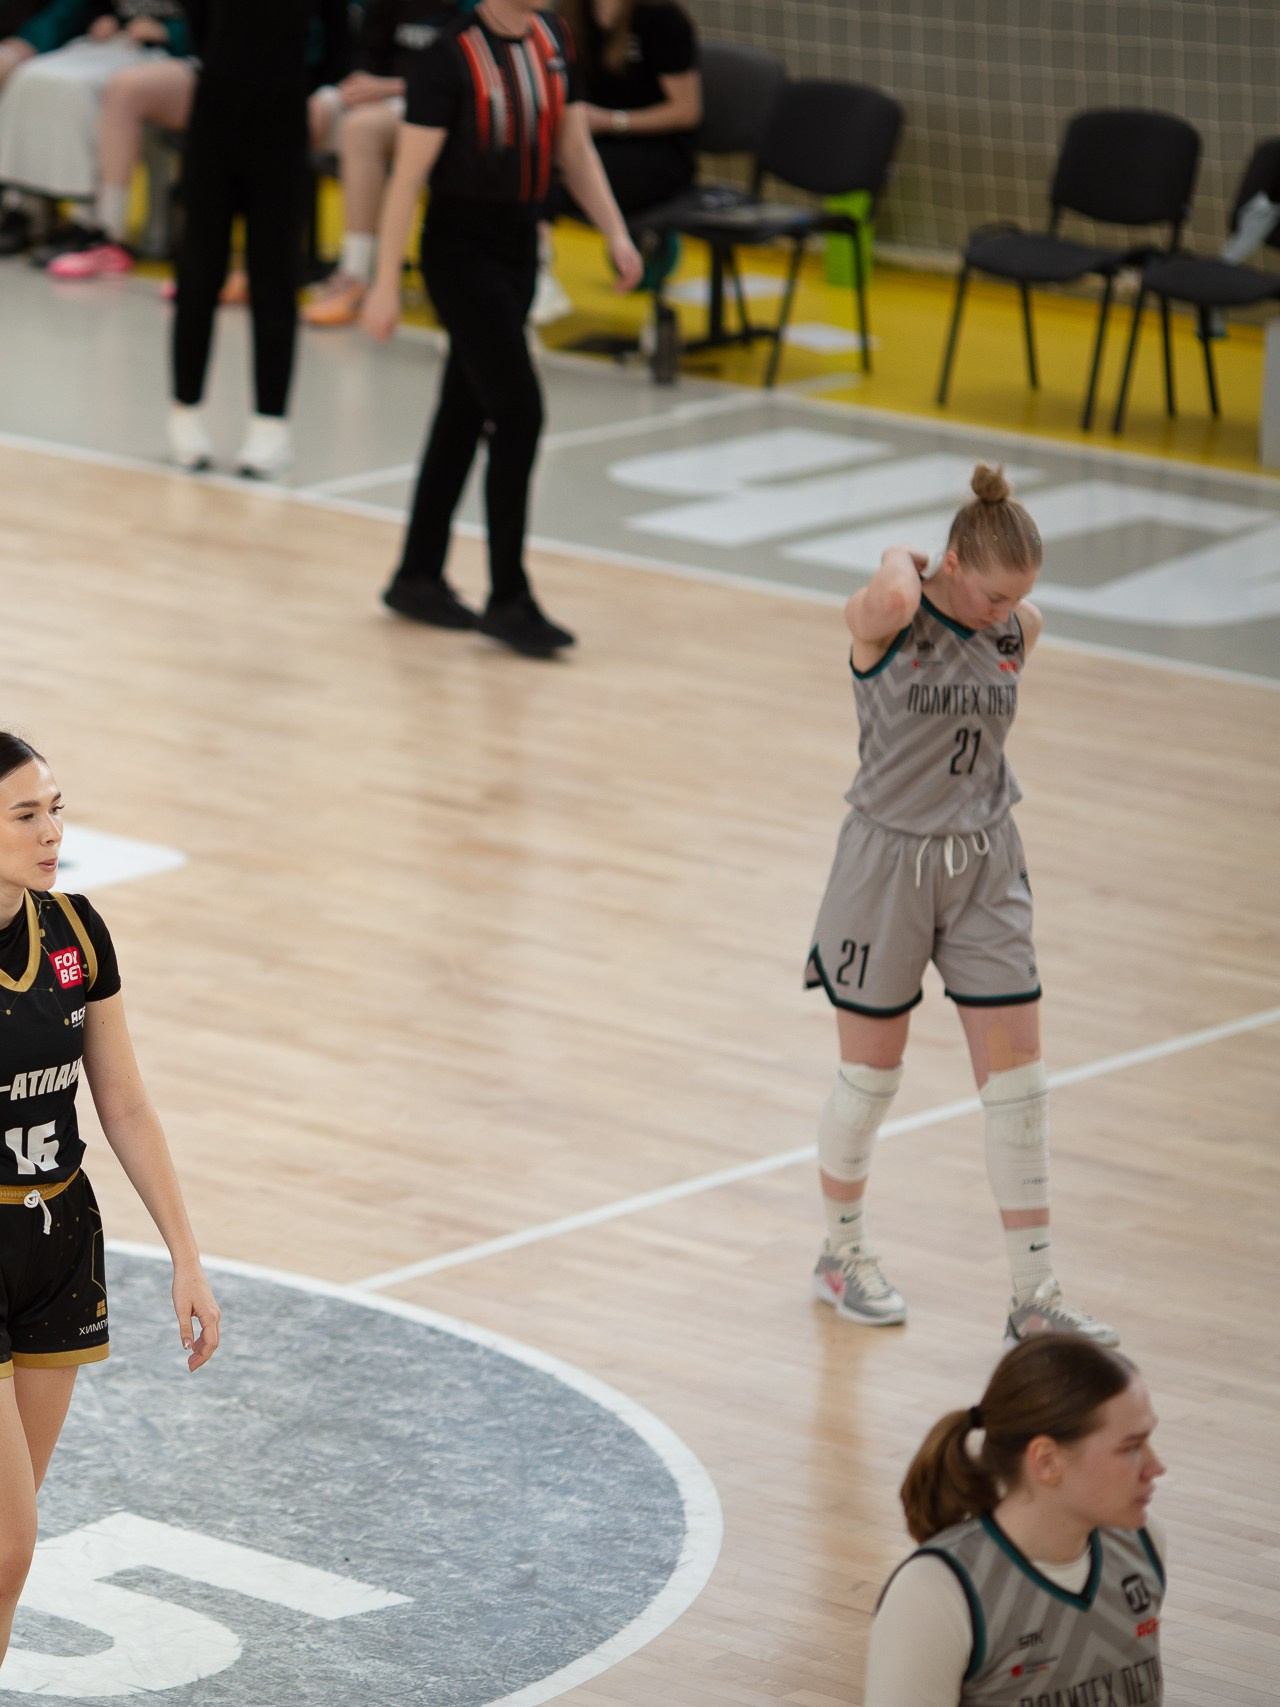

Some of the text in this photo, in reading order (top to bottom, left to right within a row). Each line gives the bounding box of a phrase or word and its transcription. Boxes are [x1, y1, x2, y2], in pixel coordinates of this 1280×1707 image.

[949, 728, 982, 776] 21
[835, 939, 872, 989] 21
[5, 1120, 59, 1175] 16
